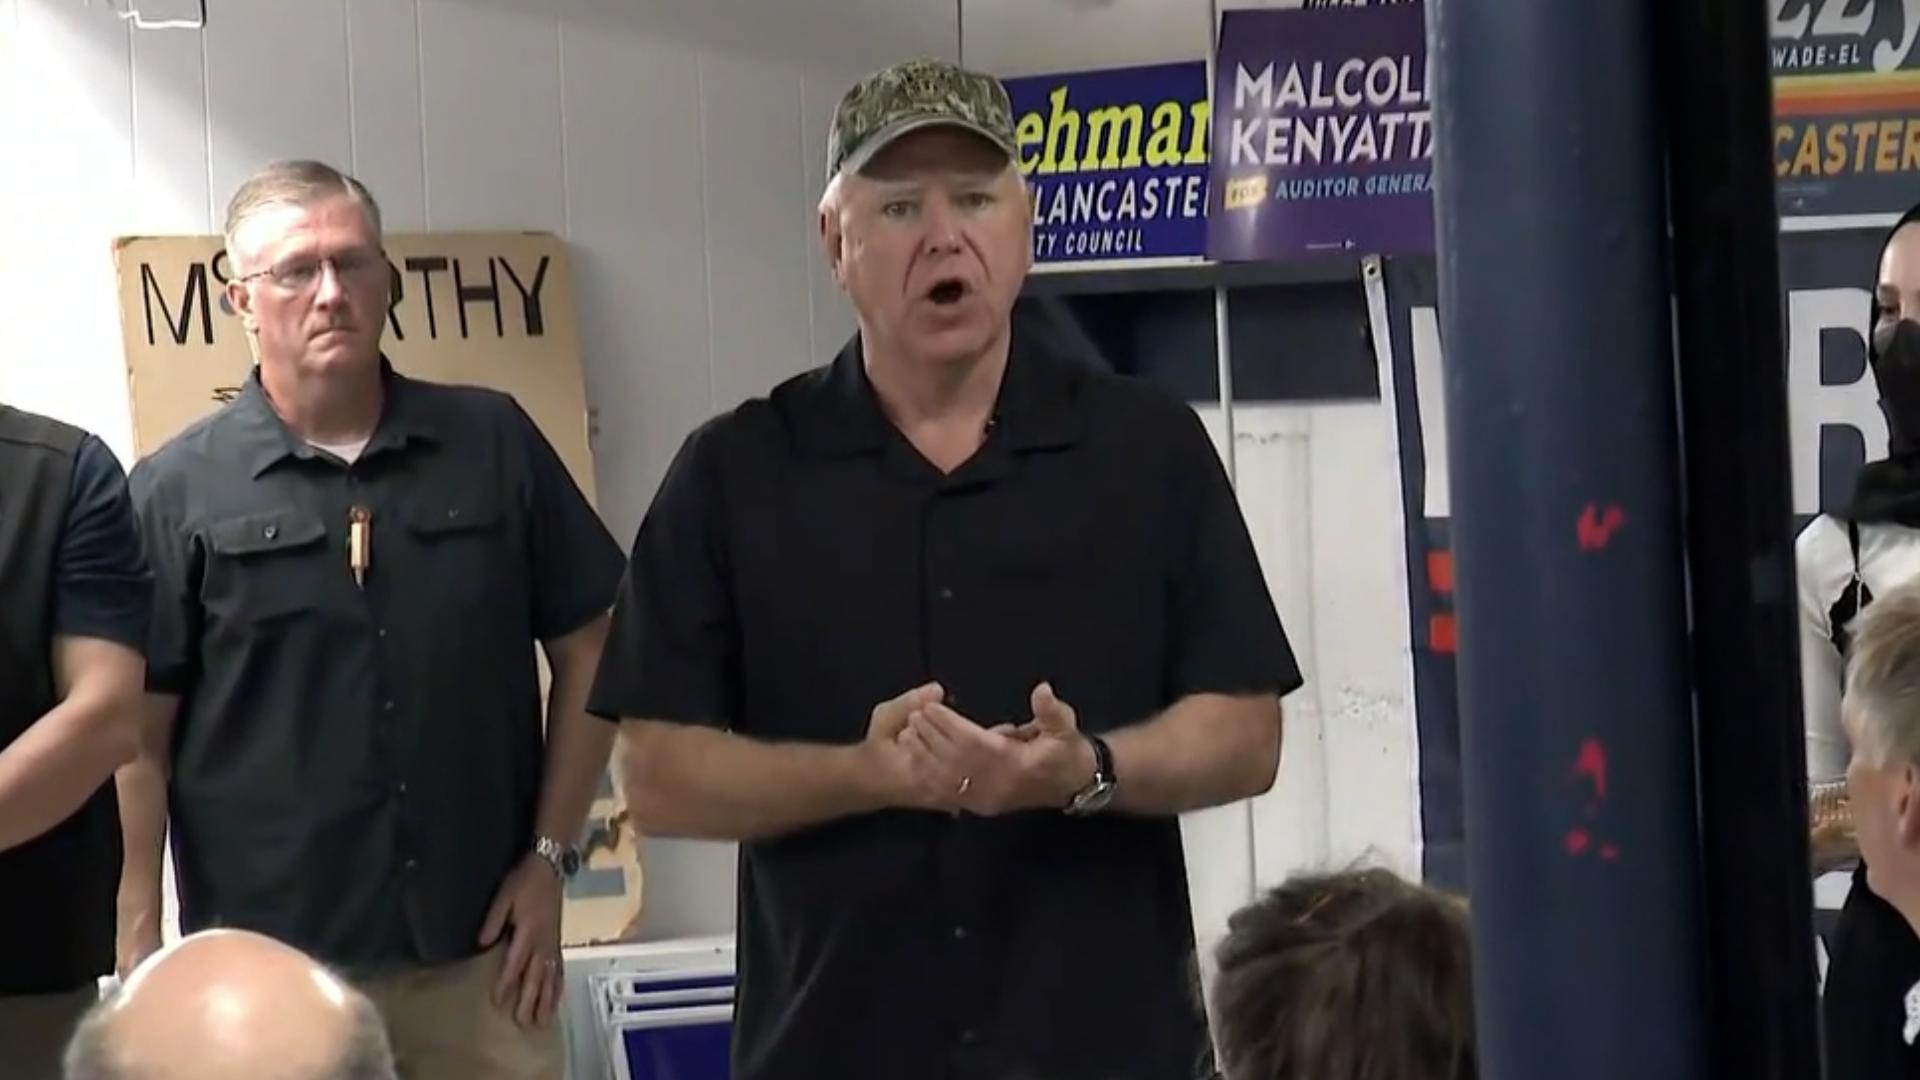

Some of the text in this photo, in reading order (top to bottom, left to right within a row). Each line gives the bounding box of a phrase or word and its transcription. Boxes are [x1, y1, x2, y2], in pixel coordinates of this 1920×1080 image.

[1771, 43, 1860, 68] WADE-EL
[1234, 55, 1431, 110] MALCOL
[1275, 175, 1360, 200] AUDITOR
[1066, 228, 1143, 255] COUNCIL
